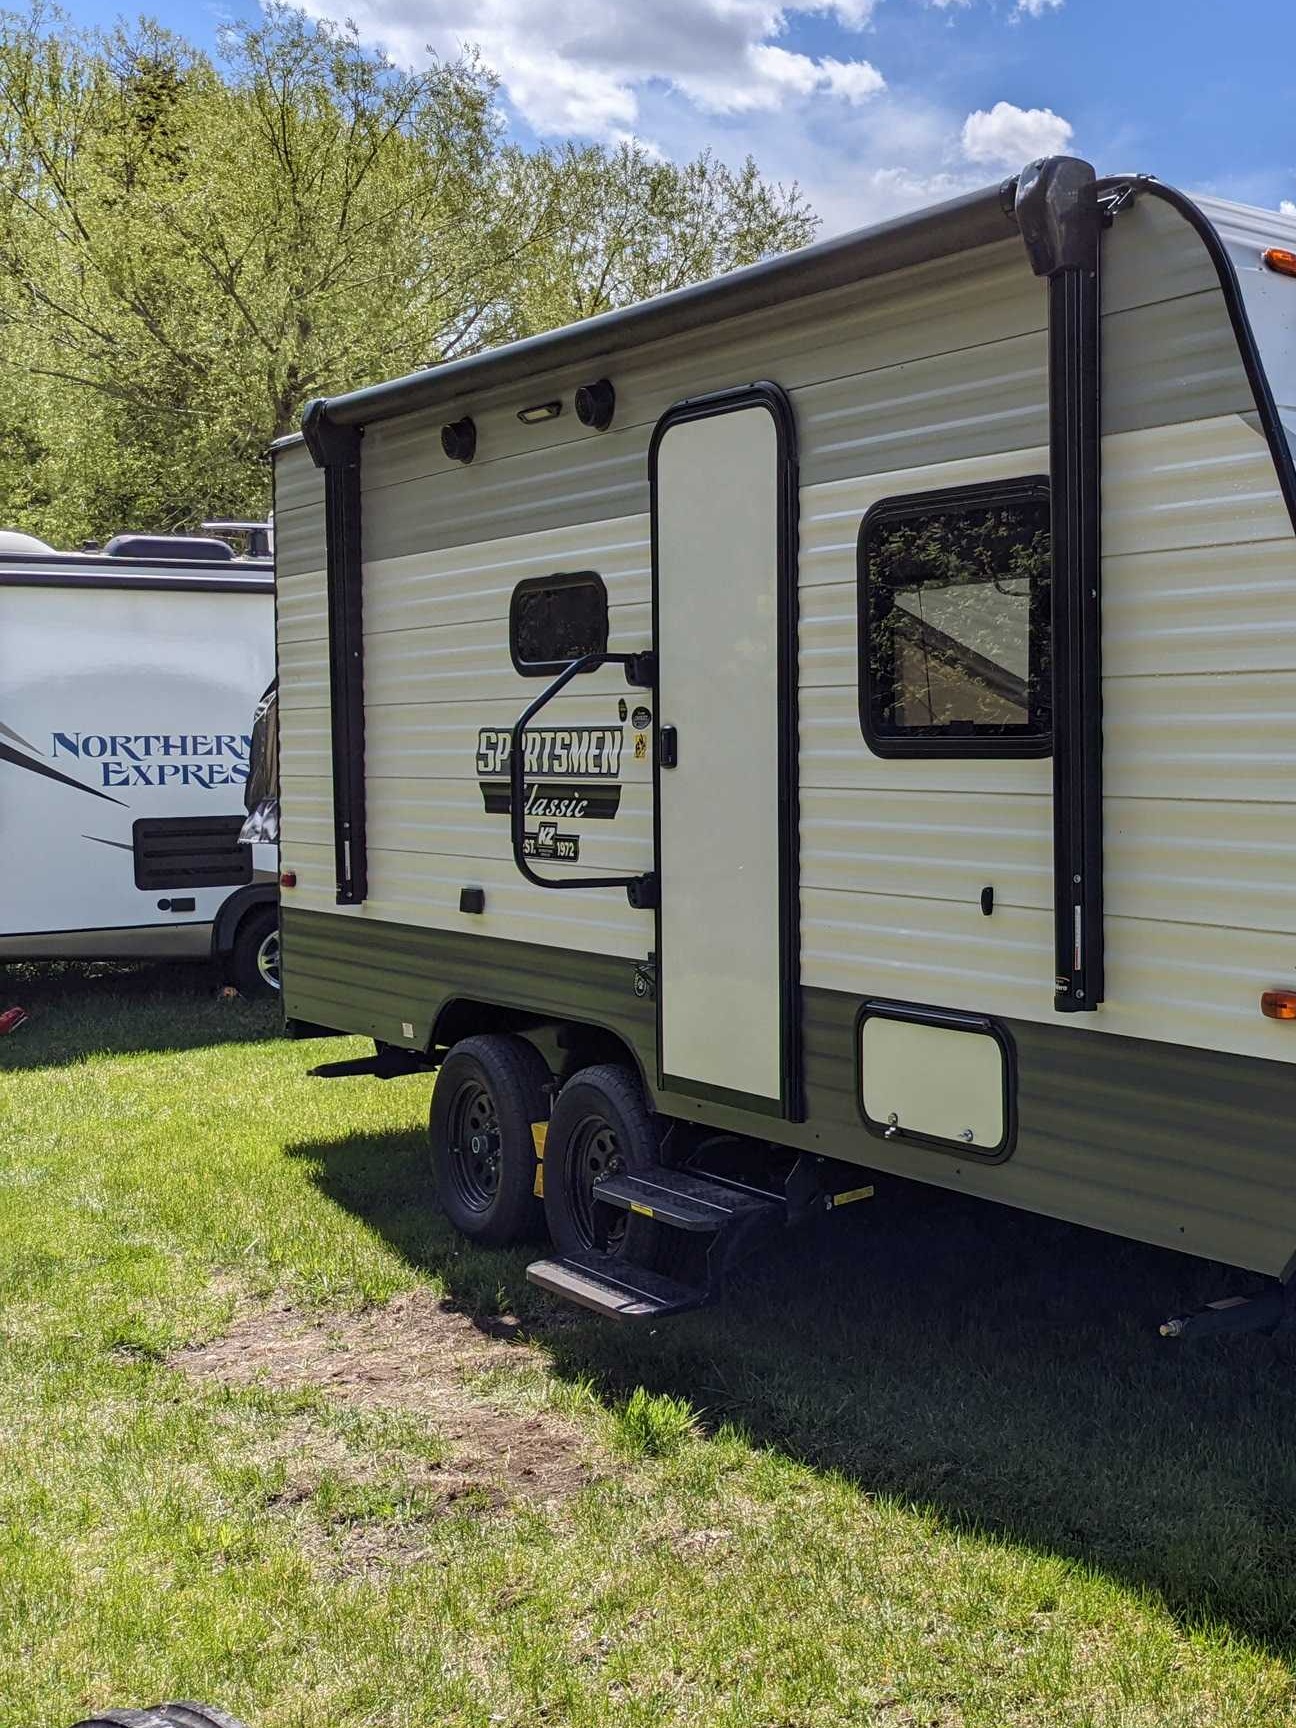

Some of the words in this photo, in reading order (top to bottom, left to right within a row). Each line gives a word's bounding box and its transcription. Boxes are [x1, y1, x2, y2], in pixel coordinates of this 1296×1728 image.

[509, 784, 588, 817] lassic
[538, 826, 556, 845] KZ
[523, 839, 537, 855] ST.
[556, 841, 575, 857] 1972
